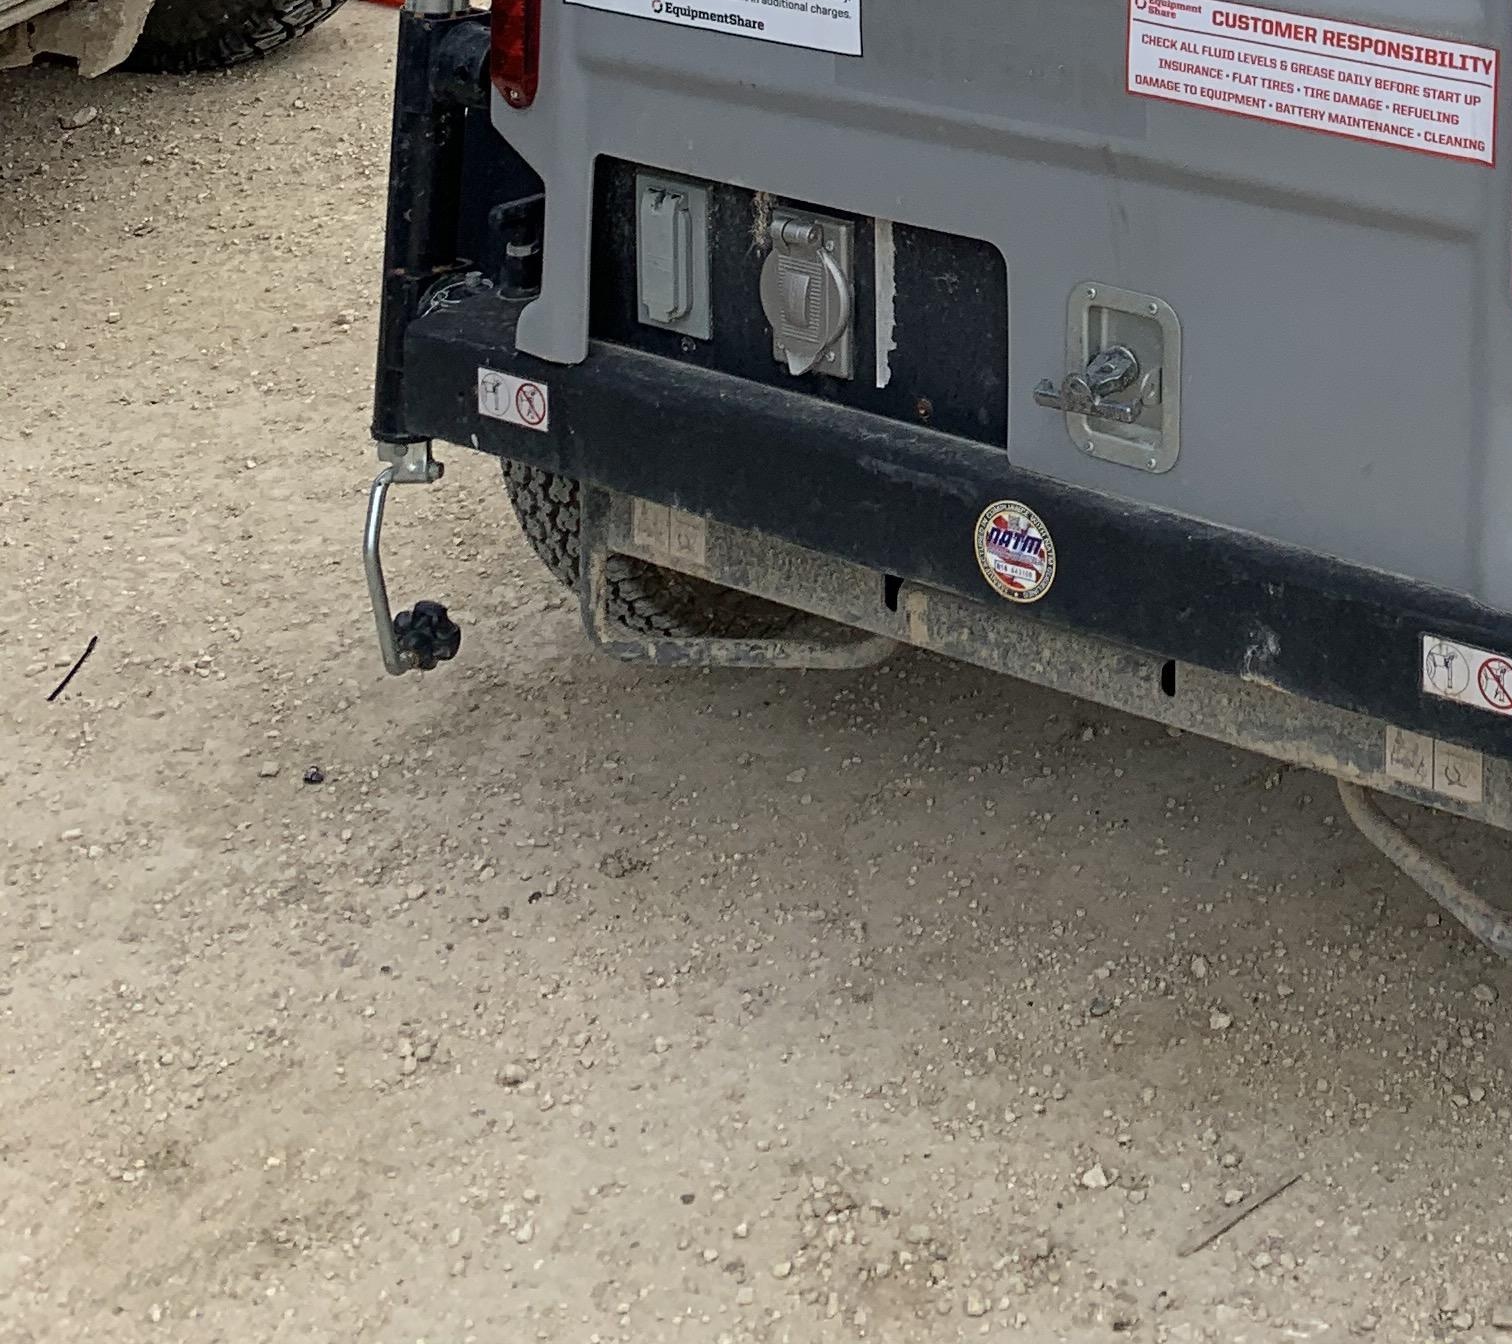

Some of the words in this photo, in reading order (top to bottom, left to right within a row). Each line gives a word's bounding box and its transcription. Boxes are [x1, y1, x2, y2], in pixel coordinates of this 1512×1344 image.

[665, 2, 765, 31] EquipmentShare
[810, 4, 852, 20] charges.
[1148, 6, 1177, 20] Share
[1212, 10, 1317, 44] CUSTOMER
[1322, 29, 1493, 76] RESPONSIBILITY
[1141, 33, 1177, 51] CHECK
[1179, 41, 1199, 55] ALL
[1202, 45, 1235, 62] FLUID
[1237, 51, 1277, 69] LEVELS
[1279, 59, 1288, 71] &
[1291, 61, 1335, 80] GREASE
[1338, 70, 1372, 88] DAILY
[1375, 77, 1420, 97] BEFORE
[1423, 87, 1461, 104] START
[1464, 94, 1481, 107] UP
[1158, 58, 1223, 82] INSURANCE
[1232, 72, 1257, 87] FLAT
[1260, 77, 1294, 93] TIRES
[1303, 85, 1331, 101] TIRE
[1333, 91, 1382, 111] DAMAGE
[1392, 103, 1459, 125] REFUELING
[1135, 74, 1181, 93] DAMAGE
[1184, 83, 1197, 95] TO
[1200, 85, 1266, 109] EQUIPMENT
[1275, 101, 1325, 122] BATTERY
[1327, 112, 1414, 139] MAINTENANCE
[1424, 131, 1485, 152] CLEANING
